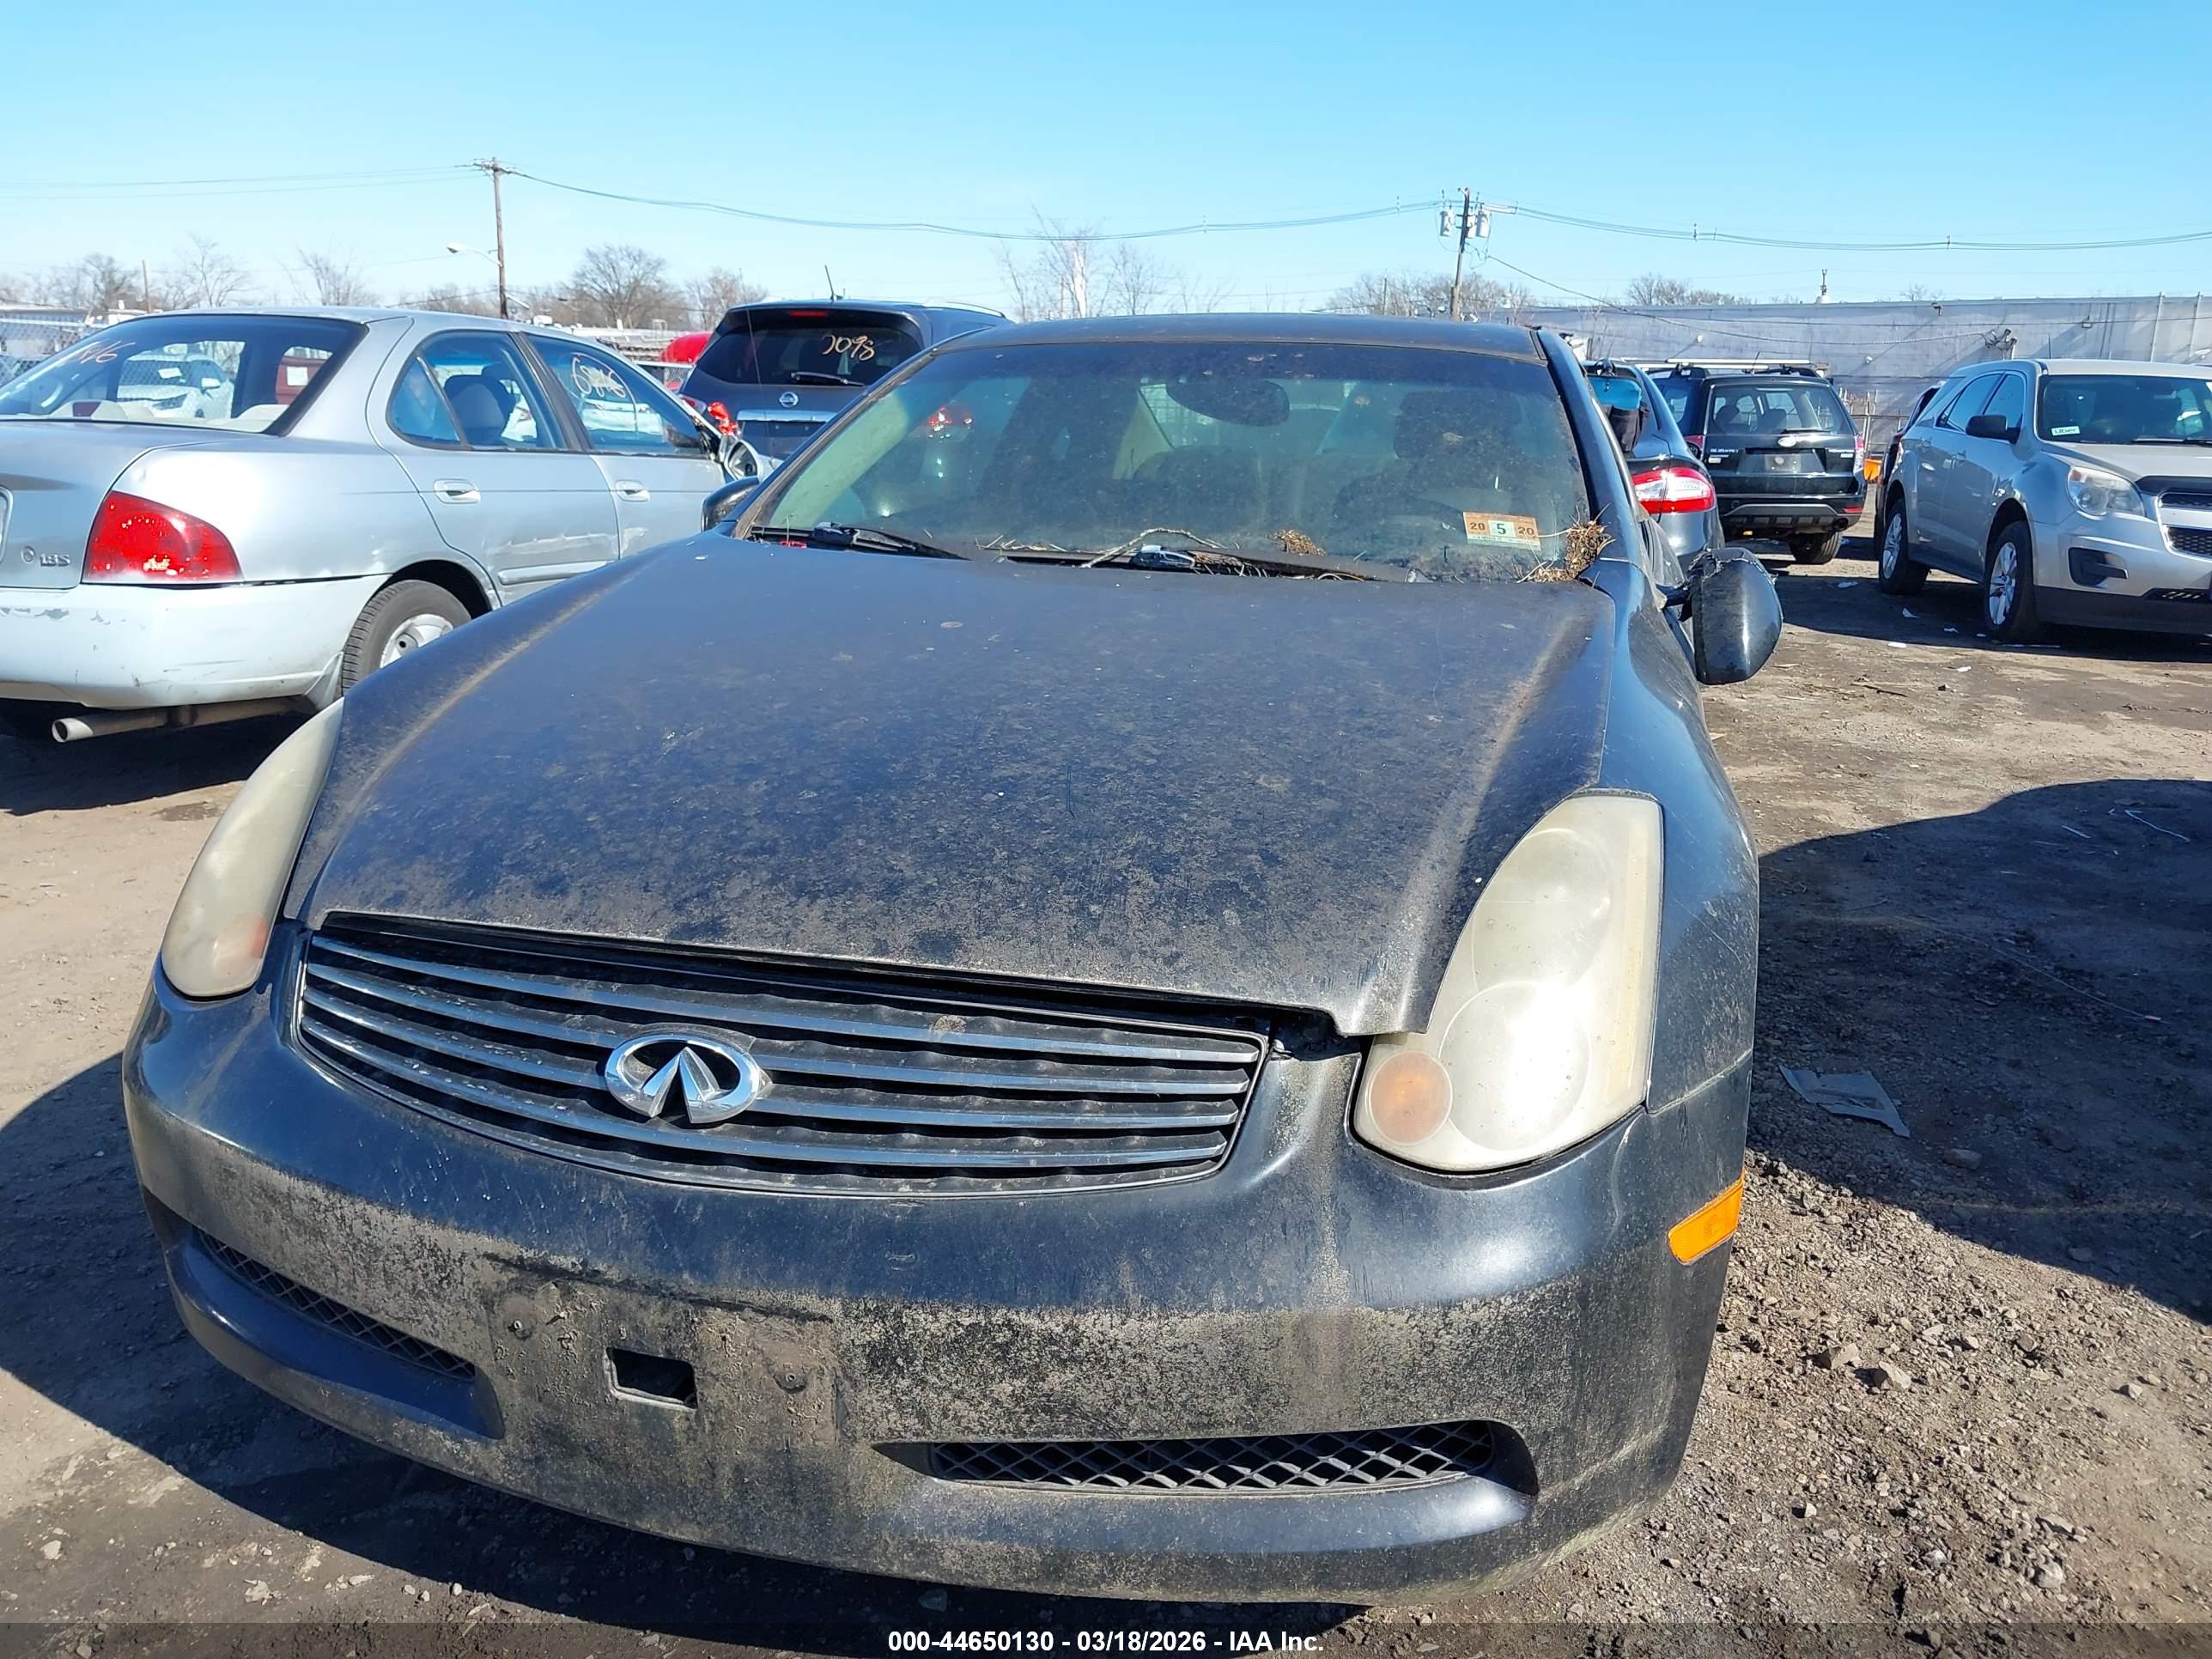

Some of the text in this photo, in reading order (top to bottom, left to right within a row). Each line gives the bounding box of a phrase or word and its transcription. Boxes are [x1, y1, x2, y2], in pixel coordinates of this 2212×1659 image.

[1470, 522, 1534, 536] 20 5 20
